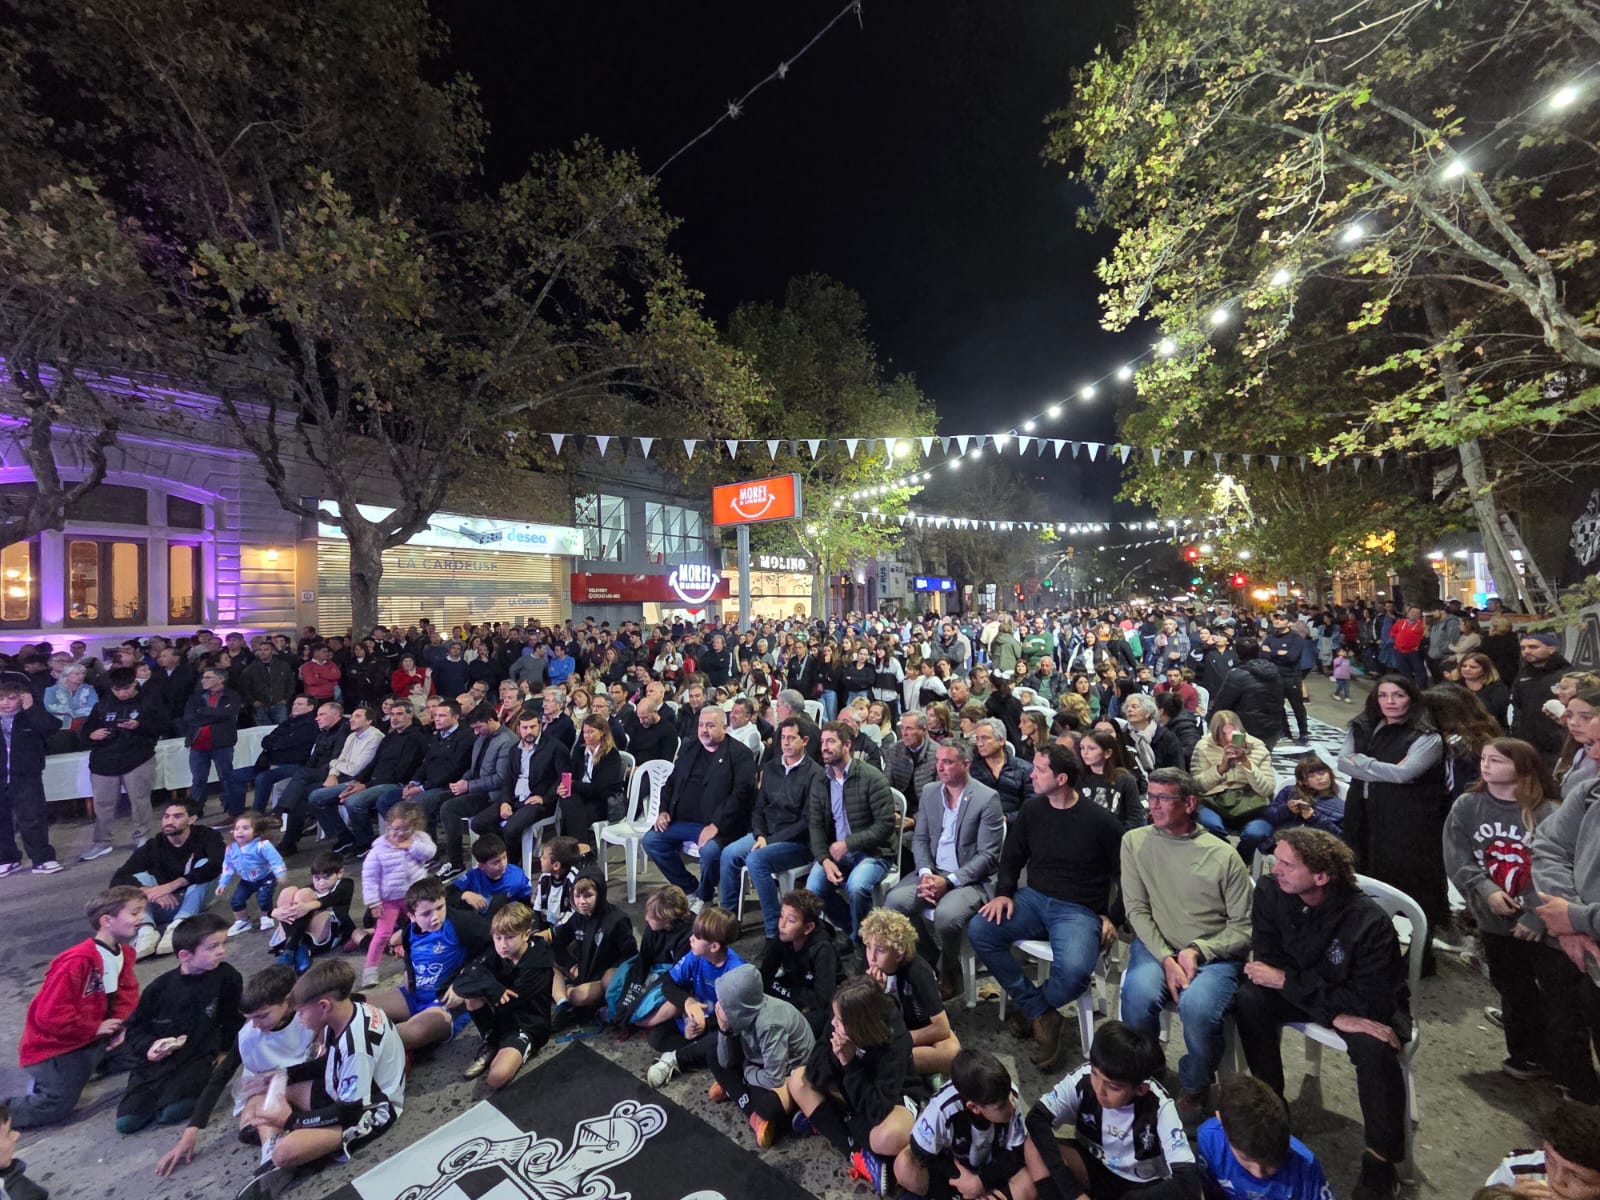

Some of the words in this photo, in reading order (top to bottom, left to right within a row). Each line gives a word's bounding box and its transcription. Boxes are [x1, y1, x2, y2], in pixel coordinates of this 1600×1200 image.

[739, 485, 767, 500] MORFI
[507, 528, 547, 544] deseo
[397, 558, 416, 568] LA
[760, 555, 806, 570] MOLINO
[679, 564, 711, 582] MORFI
